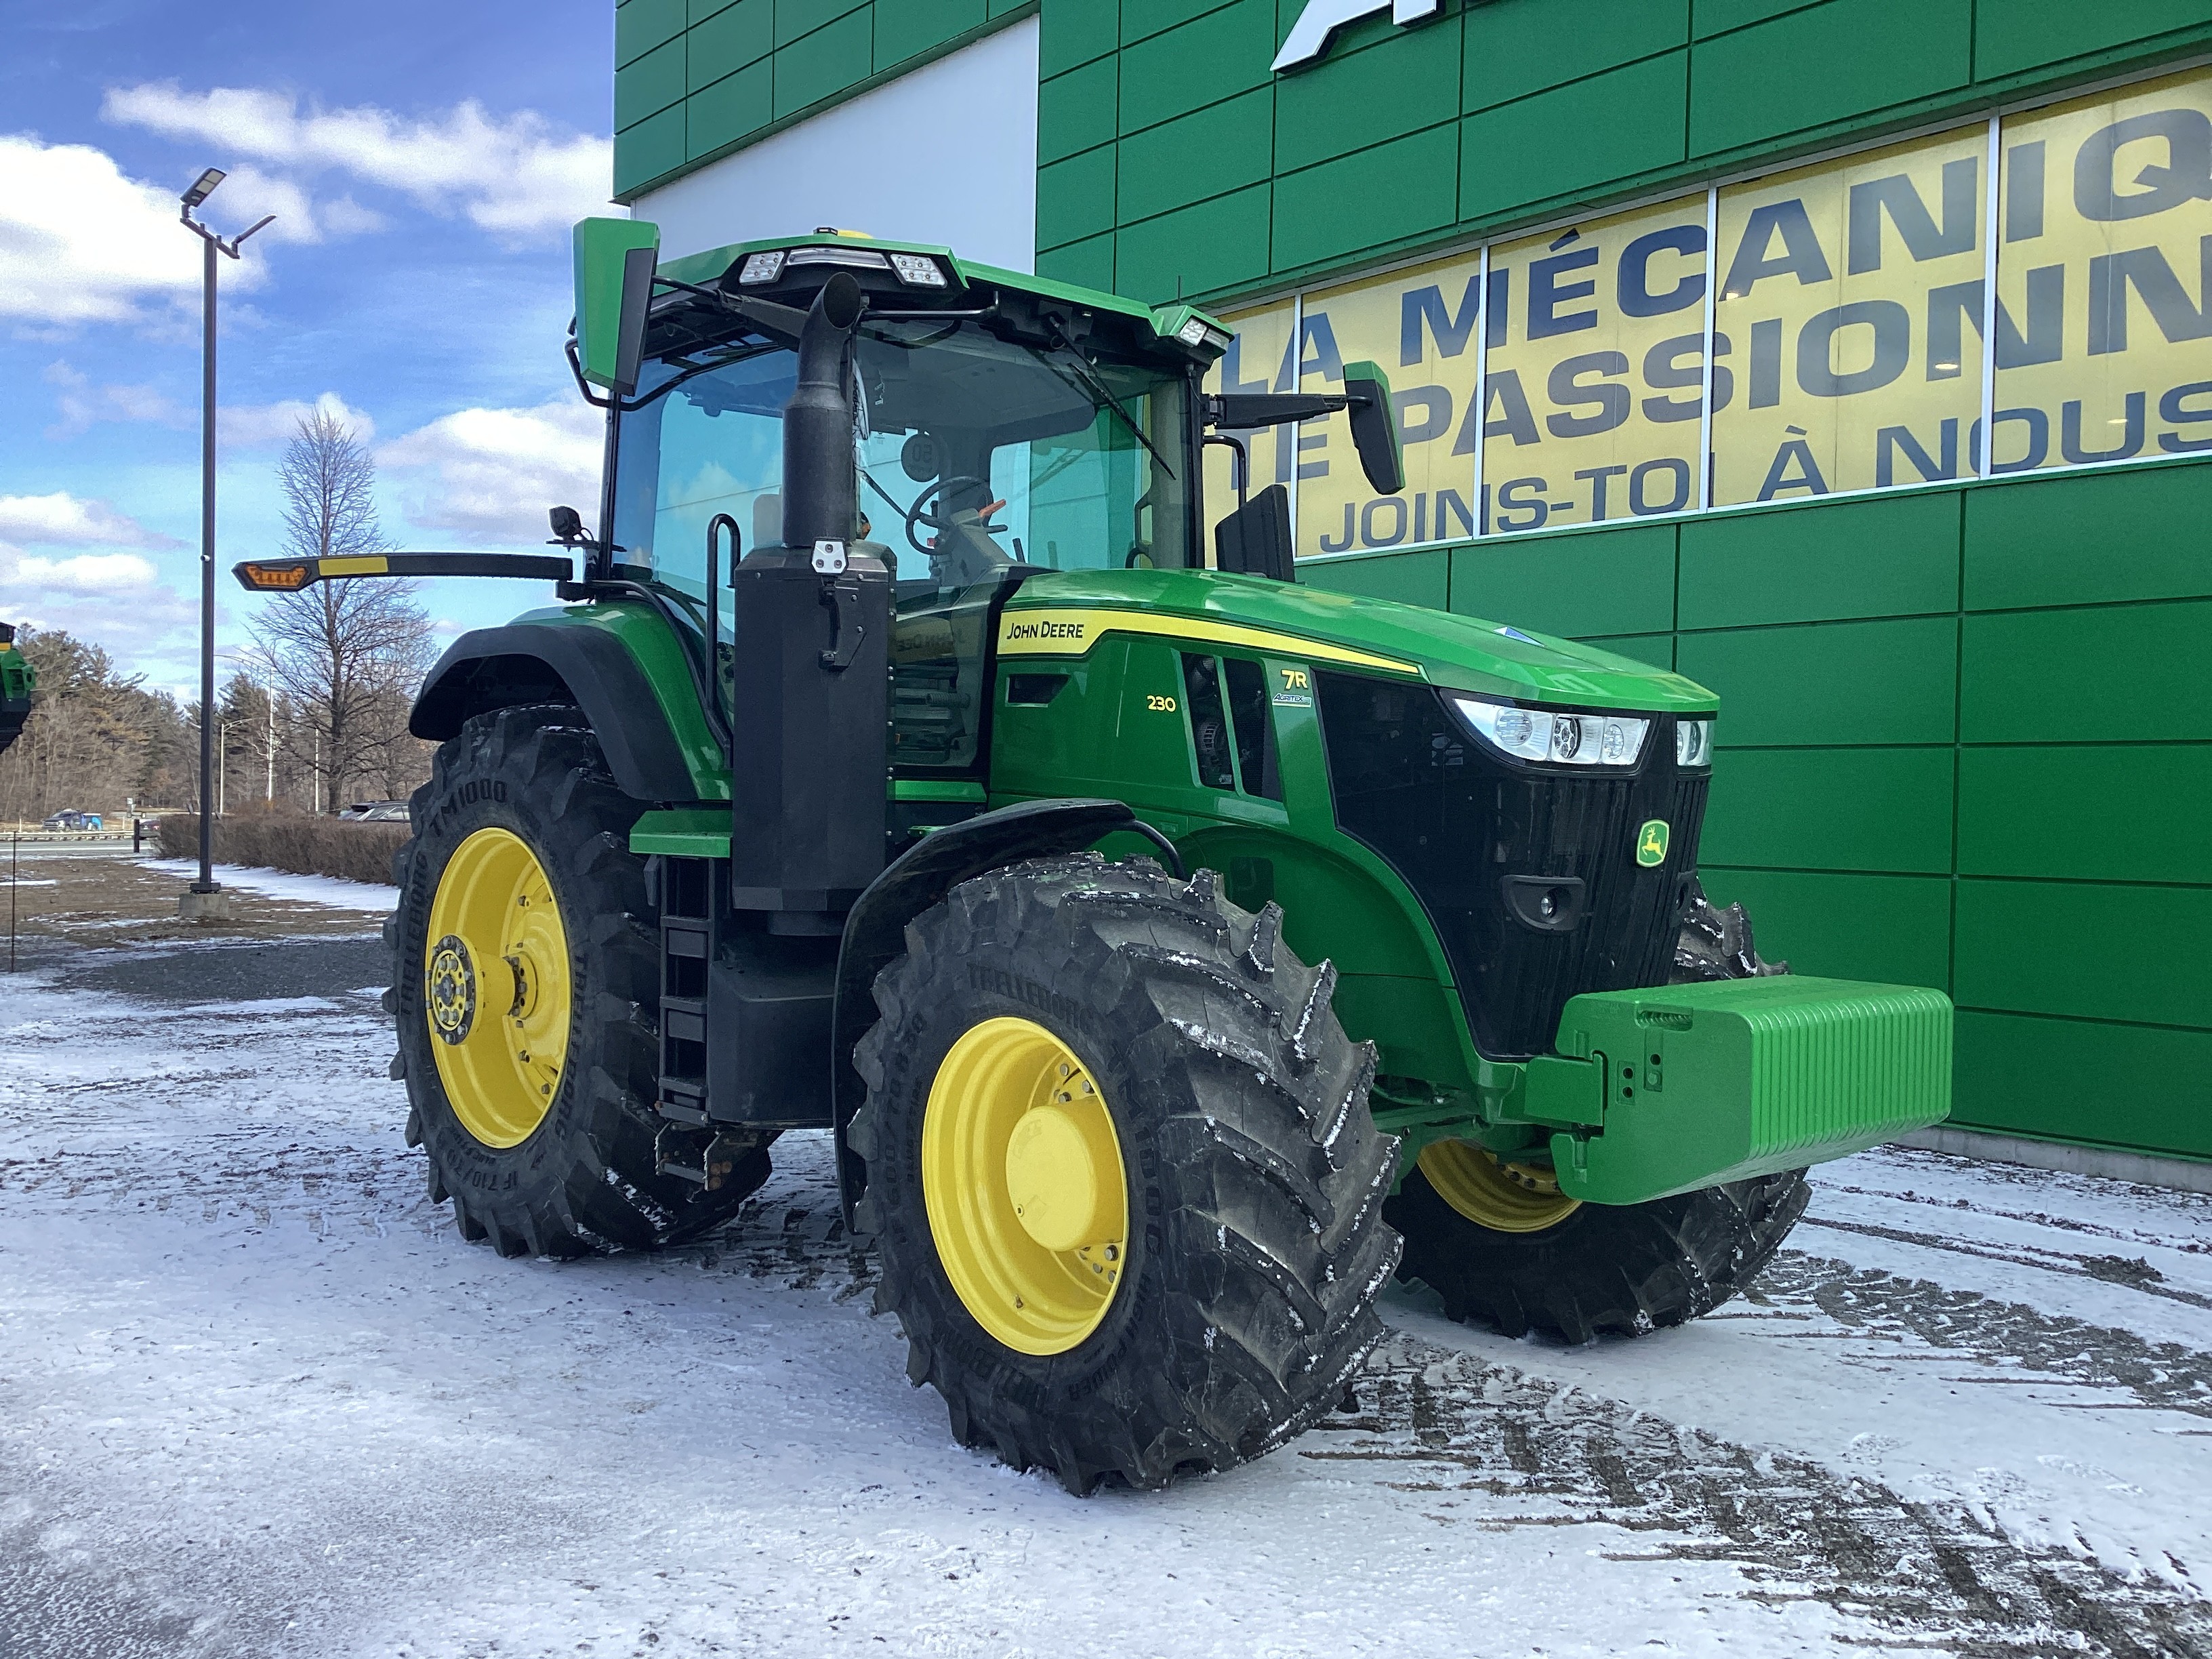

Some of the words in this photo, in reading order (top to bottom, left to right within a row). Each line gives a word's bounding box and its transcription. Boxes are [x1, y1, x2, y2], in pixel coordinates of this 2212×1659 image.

[1221, 312, 1345, 395] LA
[1391, 234, 2212, 457] PASSIONN
[1755, 425, 1830, 502] À
[1877, 380, 2212, 488] NOUS
[1006, 622, 1039, 640] JOHN
[1040, 621, 1084, 638] DEERE
[1281, 669, 1308, 689] 7R
[1147, 695, 1176, 712] 230
[1274, 693, 1304, 702] AGRITEX
